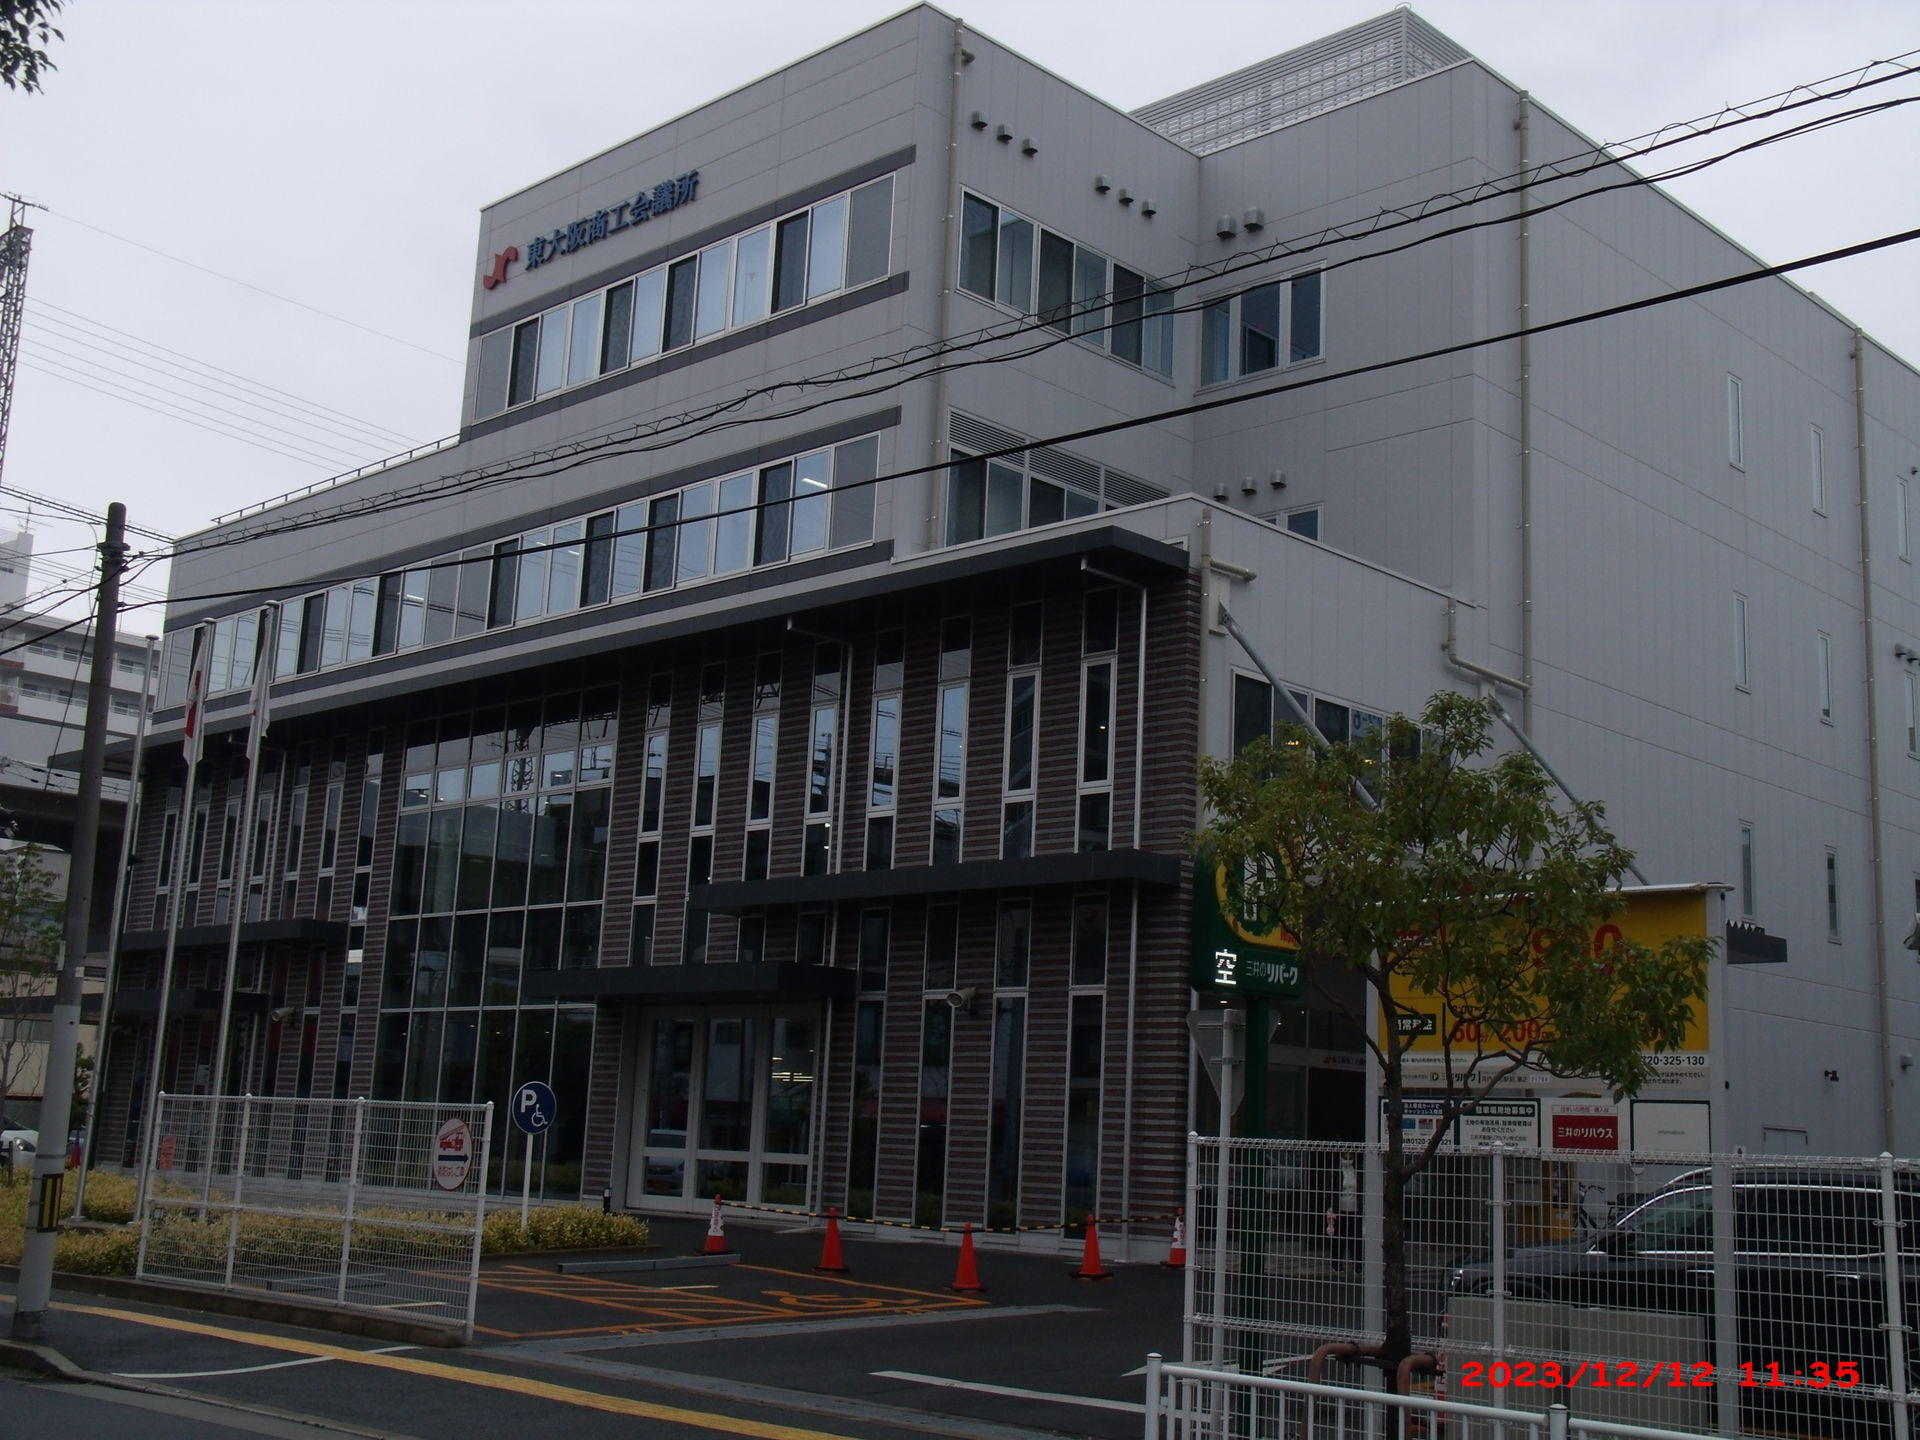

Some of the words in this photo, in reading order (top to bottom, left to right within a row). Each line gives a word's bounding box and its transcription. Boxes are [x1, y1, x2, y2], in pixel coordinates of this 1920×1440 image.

[525, 169, 700, 272] 東大阪商工会議所
[1215, 949, 1238, 985] 空
[1245, 960, 1298, 985] 三井のリパーク
[520, 1088, 538, 1113] P
[1558, 1127, 1614, 1139] 三井のリハウス
